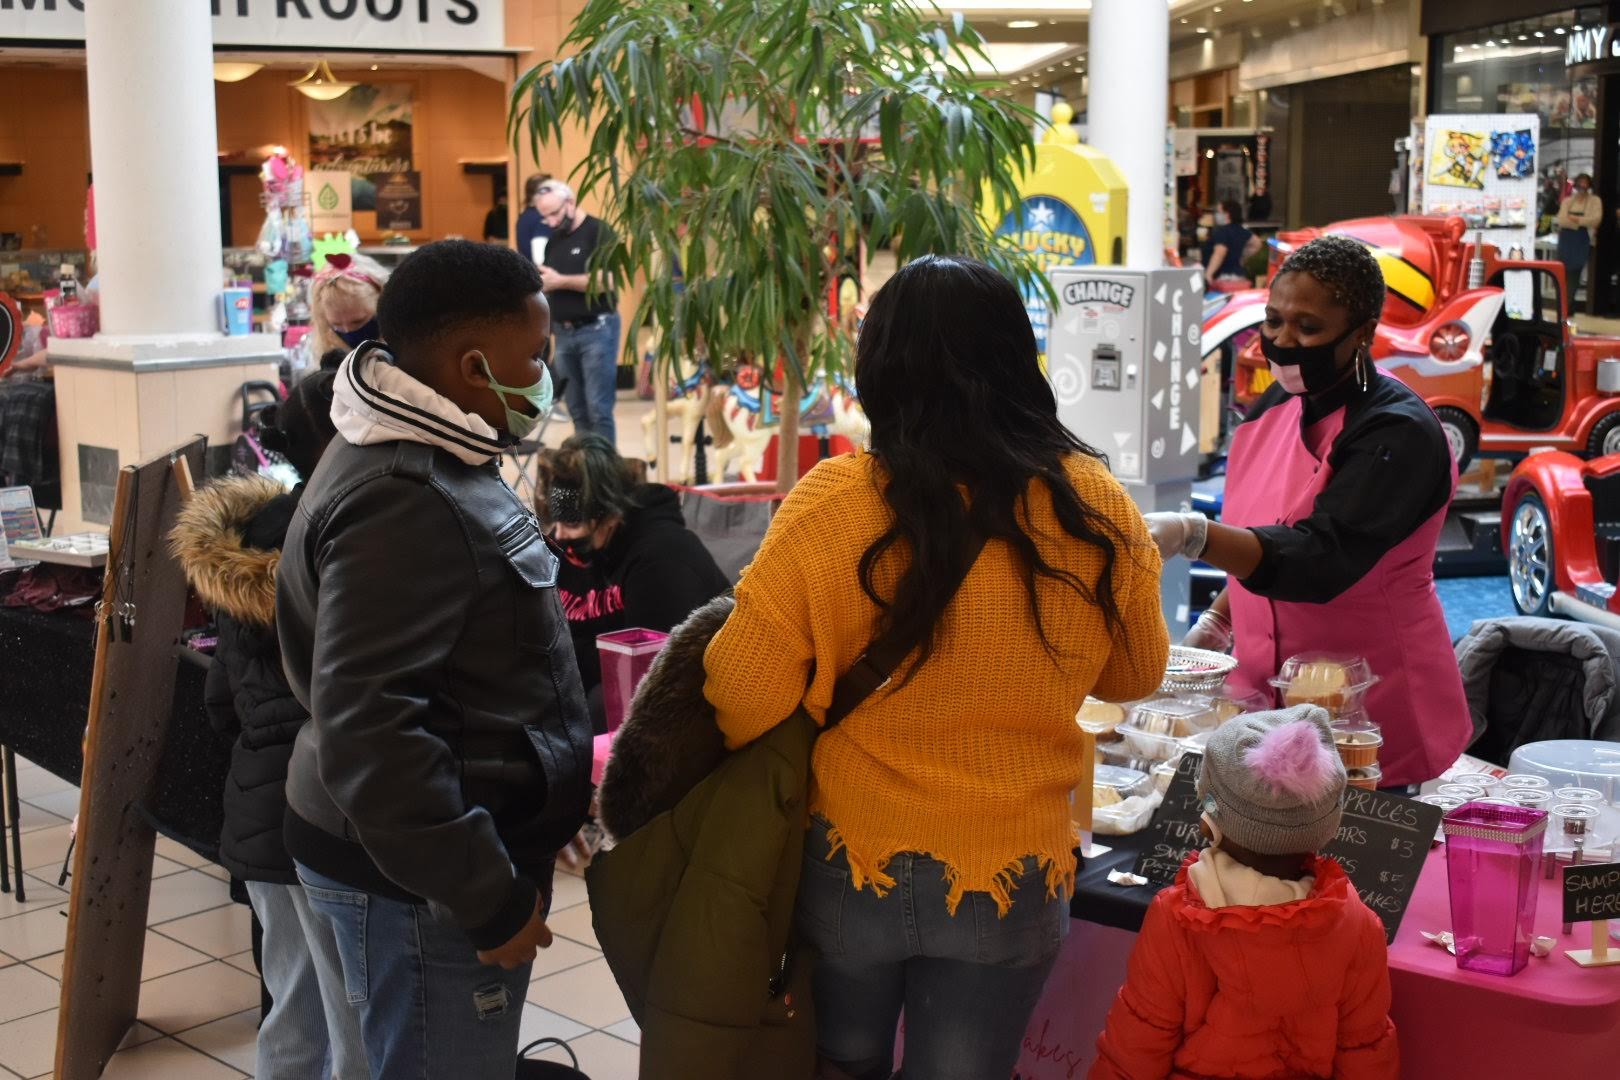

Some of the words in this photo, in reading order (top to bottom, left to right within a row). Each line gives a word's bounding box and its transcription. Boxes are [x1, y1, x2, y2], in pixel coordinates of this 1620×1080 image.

[1063, 280, 1134, 309] CHANGE
[1169, 288, 1184, 430] CHANGE
[1342, 789, 1418, 827] PRICES
[1335, 826, 1367, 845] ARS
[1390, 837, 1415, 859] $3
[1023, 1019, 1082, 1079] akes
